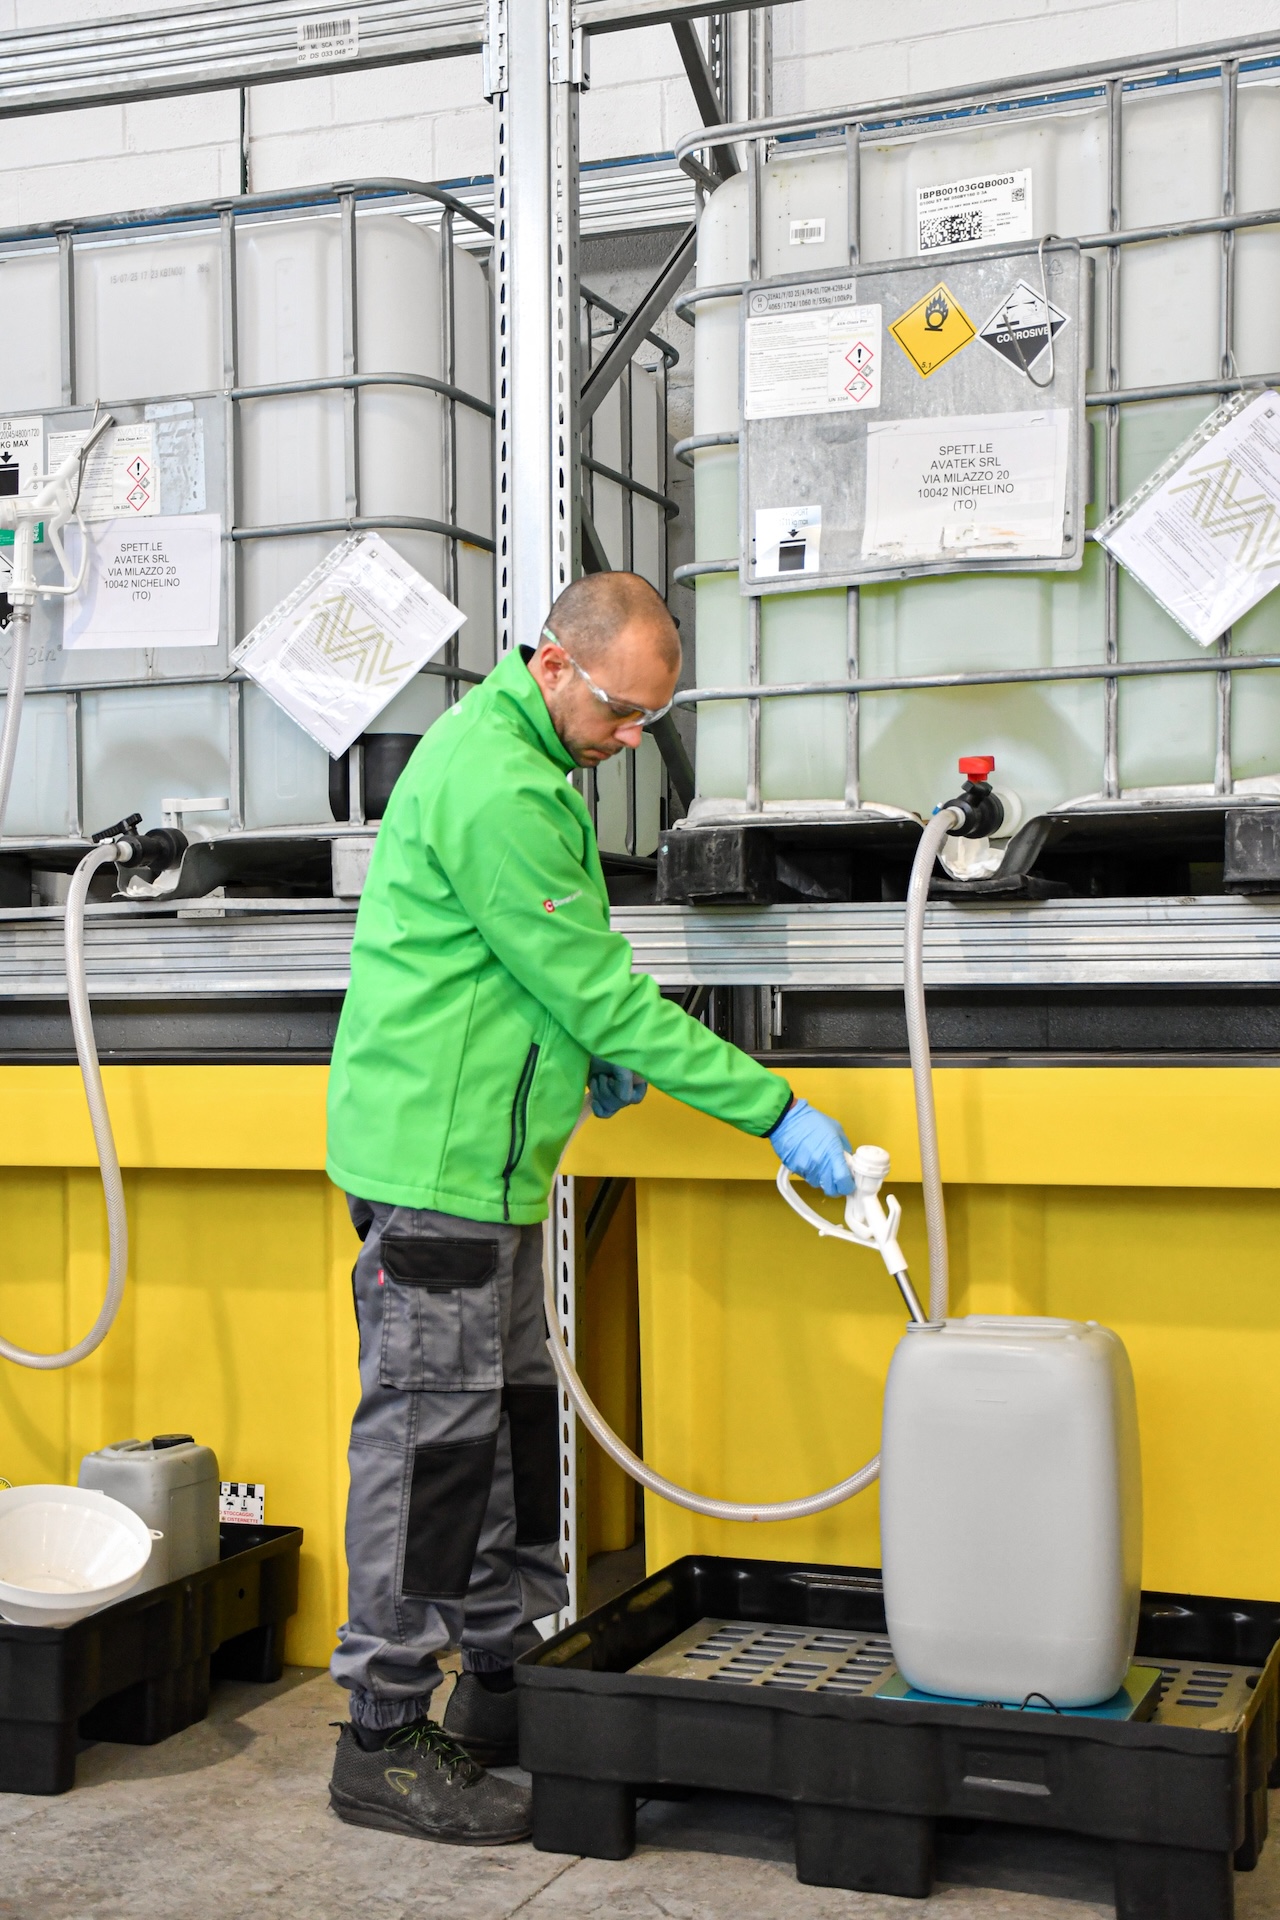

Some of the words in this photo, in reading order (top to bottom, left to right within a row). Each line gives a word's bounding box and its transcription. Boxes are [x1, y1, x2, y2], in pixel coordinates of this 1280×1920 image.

[921, 361, 932, 369] 5.1
[939, 443, 993, 456] SPETT.LE
[930, 458, 976, 470] AVATEK
[979, 457, 1001, 467] SRL
[922, 474, 941, 484] VIA
[943, 470, 993, 483] MILAZZO
[996, 470, 1010, 480] 20
[918, 487, 948, 498] 10042
[951, 483, 1014, 496] NICHELINO
[953, 499, 977, 511] (TO)
[120, 542, 163, 552] SPETT.LE
[114, 554, 150, 564] AVATEK
[151, 554, 169, 563] SRL
[108, 568, 123, 576] VIA
[124, 566, 164, 576] MILAZZO
[166, 566, 177, 575] 20
[104, 580, 129, 588] 10042
[131, 578, 180, 588] NICHELINO
[132, 590, 151, 601] (TO)
